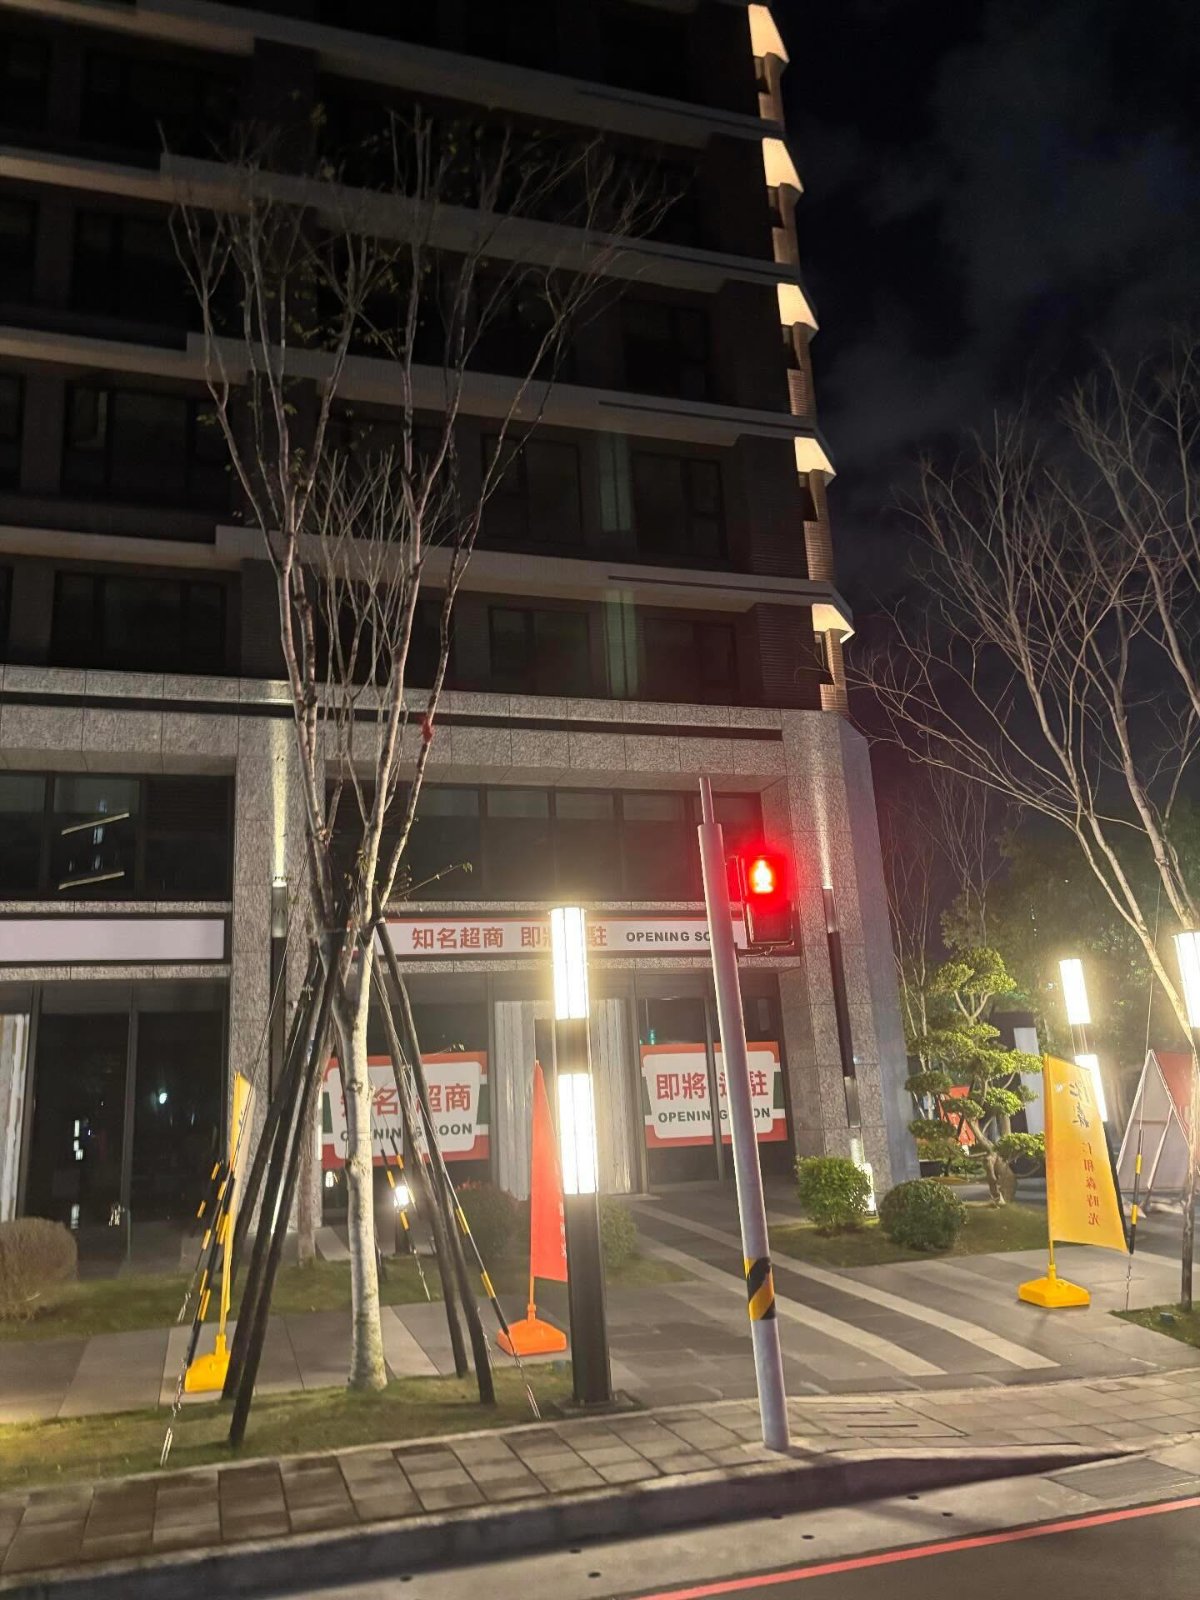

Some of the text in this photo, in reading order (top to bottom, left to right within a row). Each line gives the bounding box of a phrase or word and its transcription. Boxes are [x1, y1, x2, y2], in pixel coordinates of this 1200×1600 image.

[411, 927, 504, 949] 知名超商
[626, 932, 690, 942] OPENING
[658, 1108, 728, 1123] OPENING
[435, 1123, 473, 1136] OON
